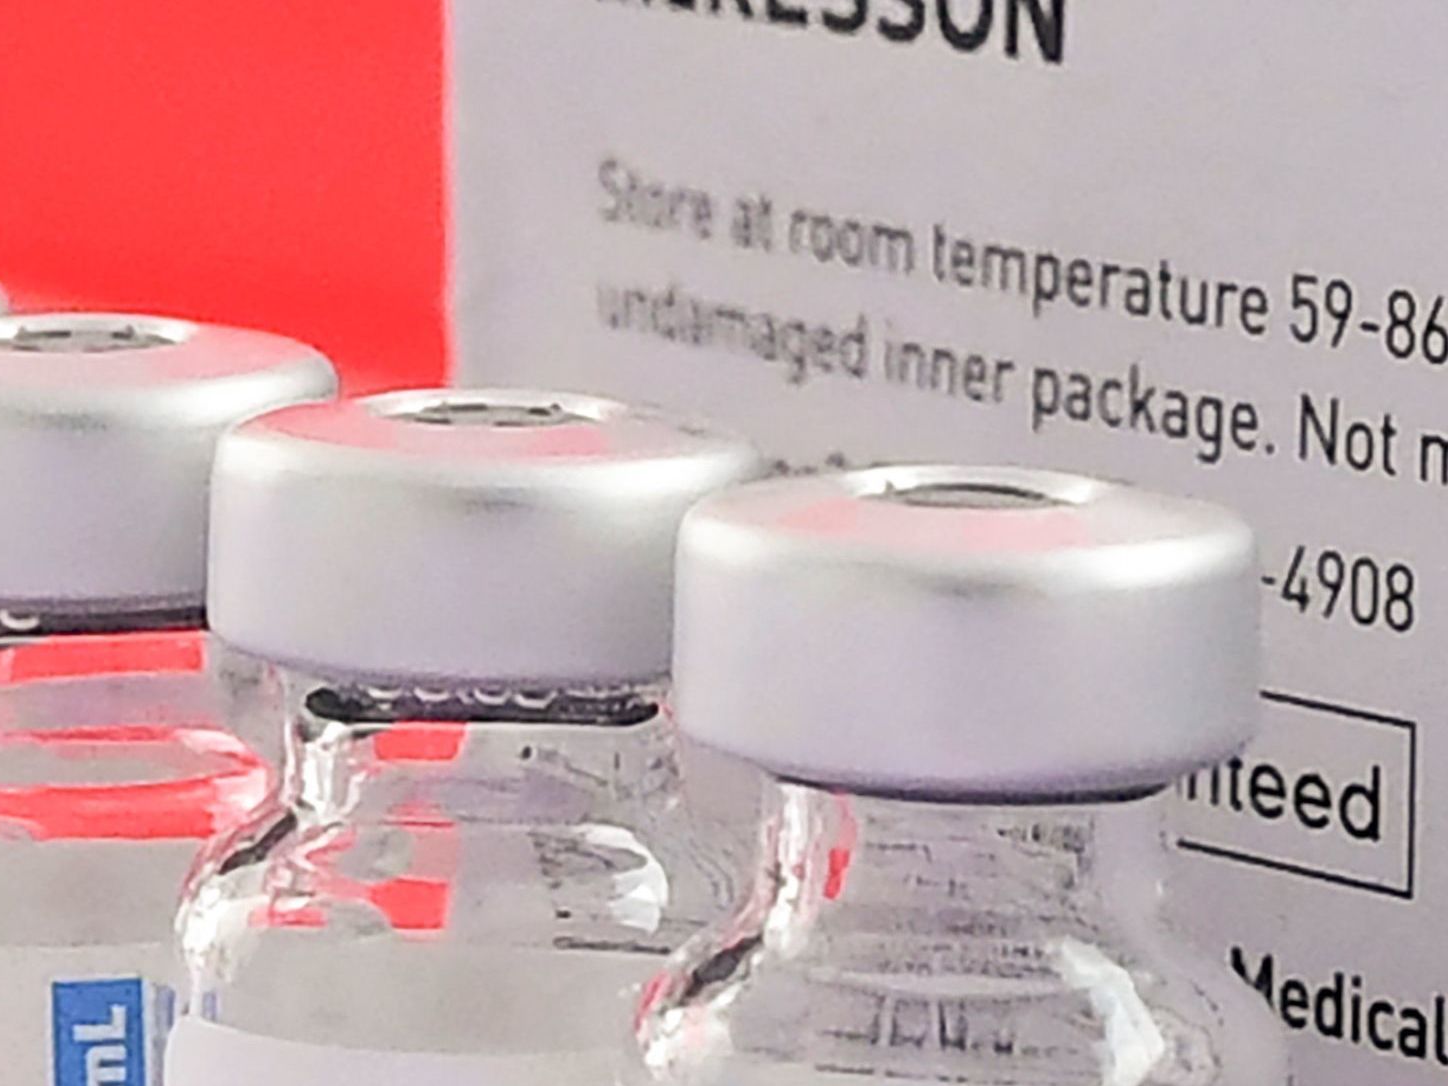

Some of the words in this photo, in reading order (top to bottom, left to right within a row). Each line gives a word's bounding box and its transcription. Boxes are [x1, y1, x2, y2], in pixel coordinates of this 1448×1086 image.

[598, 154, 712, 240] Store
[731, 194, 773, 252] at
[789, 208, 914, 276] room
[931, 222, 1269, 335] temperature
[598, 284, 868, 386] undamaged
[884, 316, 1014, 403] inner
[1032, 362, 1276, 464] package.
[1298, 393, 1397, 477] Not
